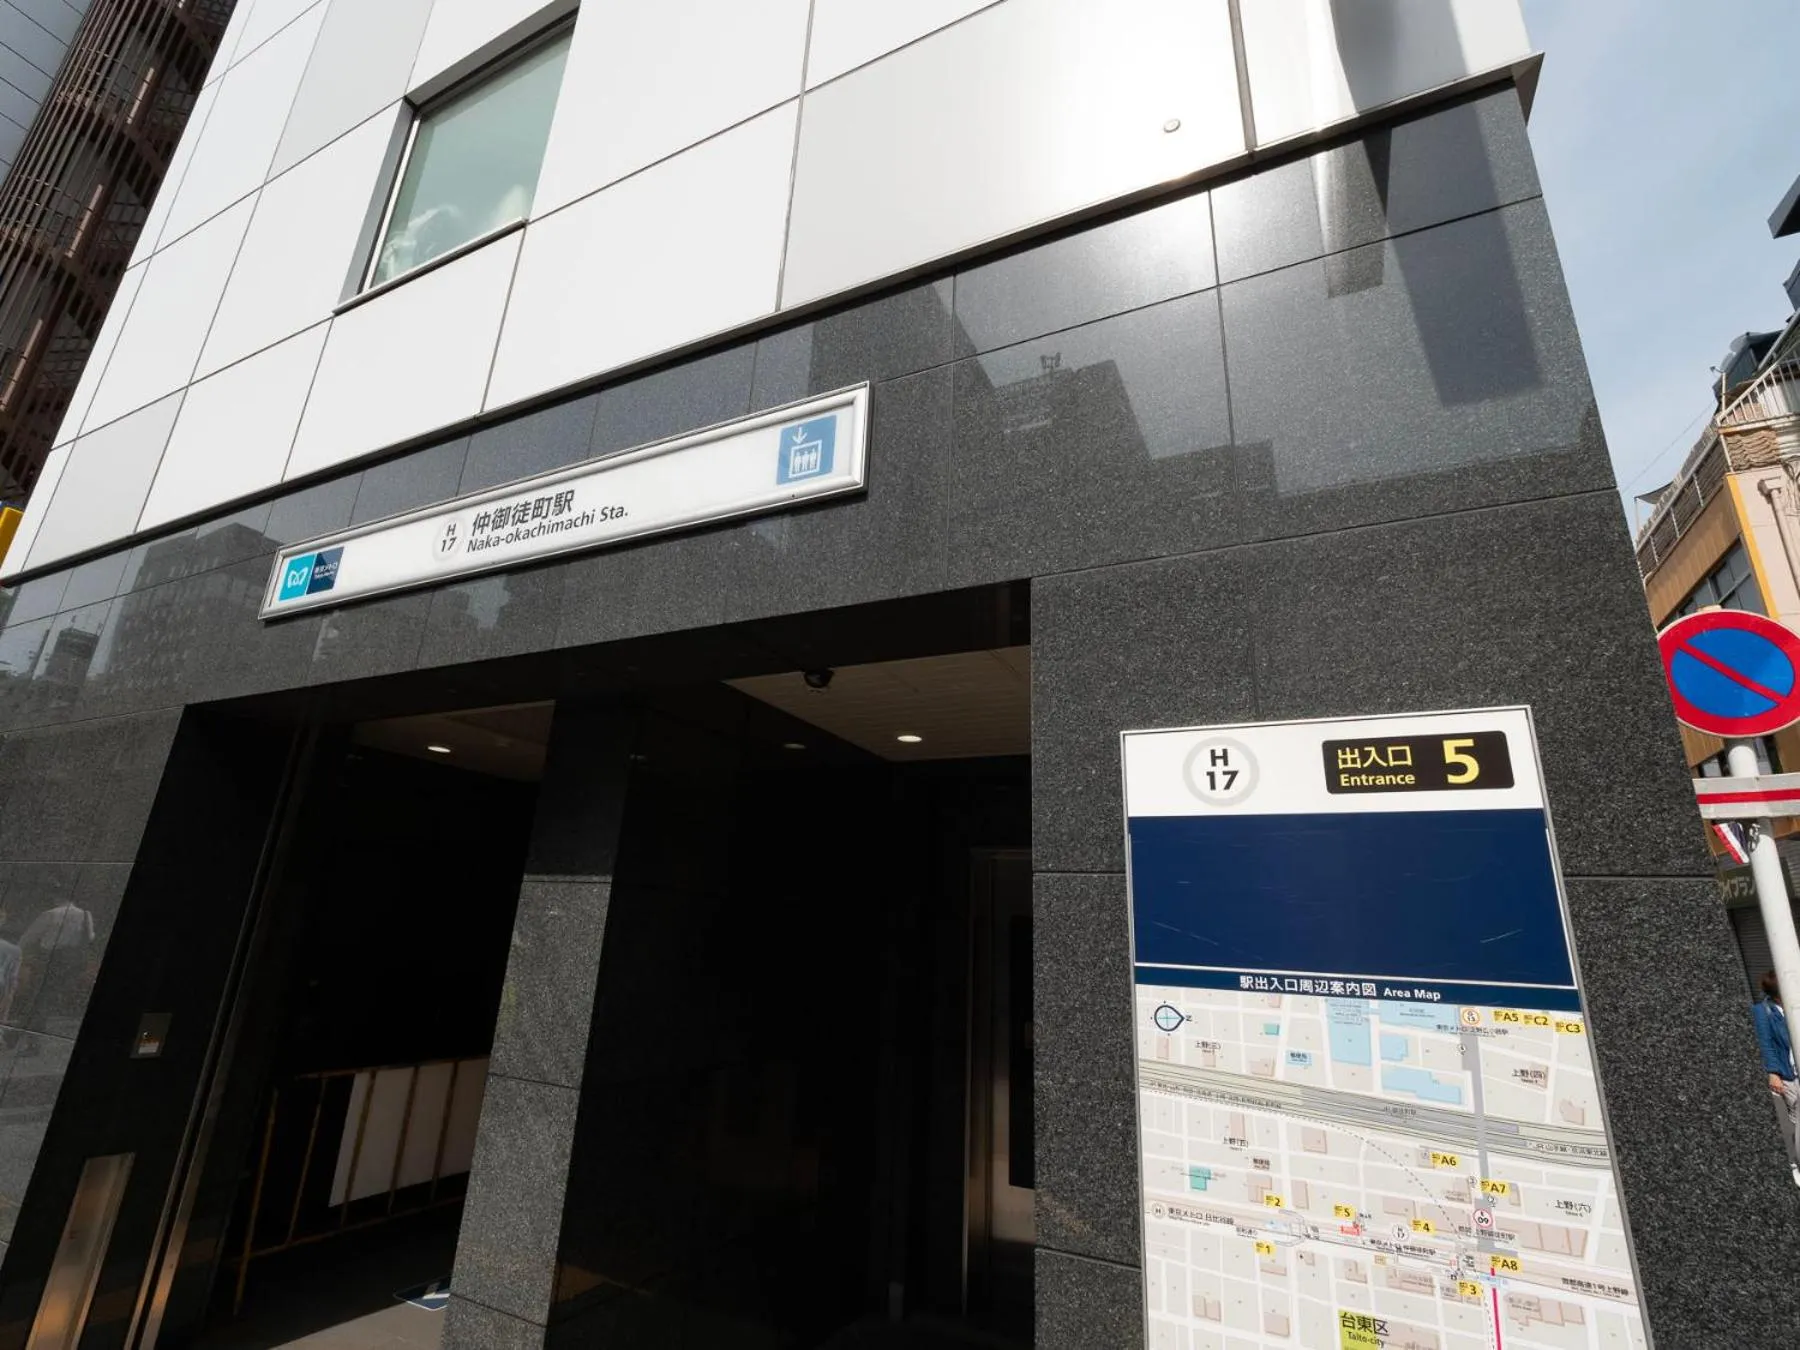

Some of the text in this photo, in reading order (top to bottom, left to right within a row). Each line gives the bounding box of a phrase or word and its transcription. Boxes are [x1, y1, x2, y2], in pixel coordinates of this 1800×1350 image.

[472, 489, 575, 537] 仲御徒町駅
[446, 523, 457, 537] H
[467, 504, 629, 553] Naka-okachimachi Sta.
[441, 536, 457, 552] 17
[1210, 748, 1228, 767] H
[1337, 745, 1413, 770] 出入口
[1441, 738, 1480, 785] 5
[1206, 769, 1239, 791] 17
[1340, 770, 1416, 787] Entrance
[1239, 975, 1441, 1002] 駅出入口周辺案内図 Area Map
[1503, 1012, 1519, 1022] A5
[1533, 1015, 1549, 1026] C2
[1565, 1023, 1581, 1033] C3
[1440, 1155, 1457, 1167] A6
[1490, 1183, 1506, 1194] A7
[1274, 1197, 1281, 1207] 2
[1422, 1222, 1430, 1232] 4
[1501, 1259, 1518, 1271] A8
[1470, 1284, 1477, 1295] 3
[1340, 1311, 1389, 1337] 台東区
[1347, 1331, 1385, 1348] Taito-city
